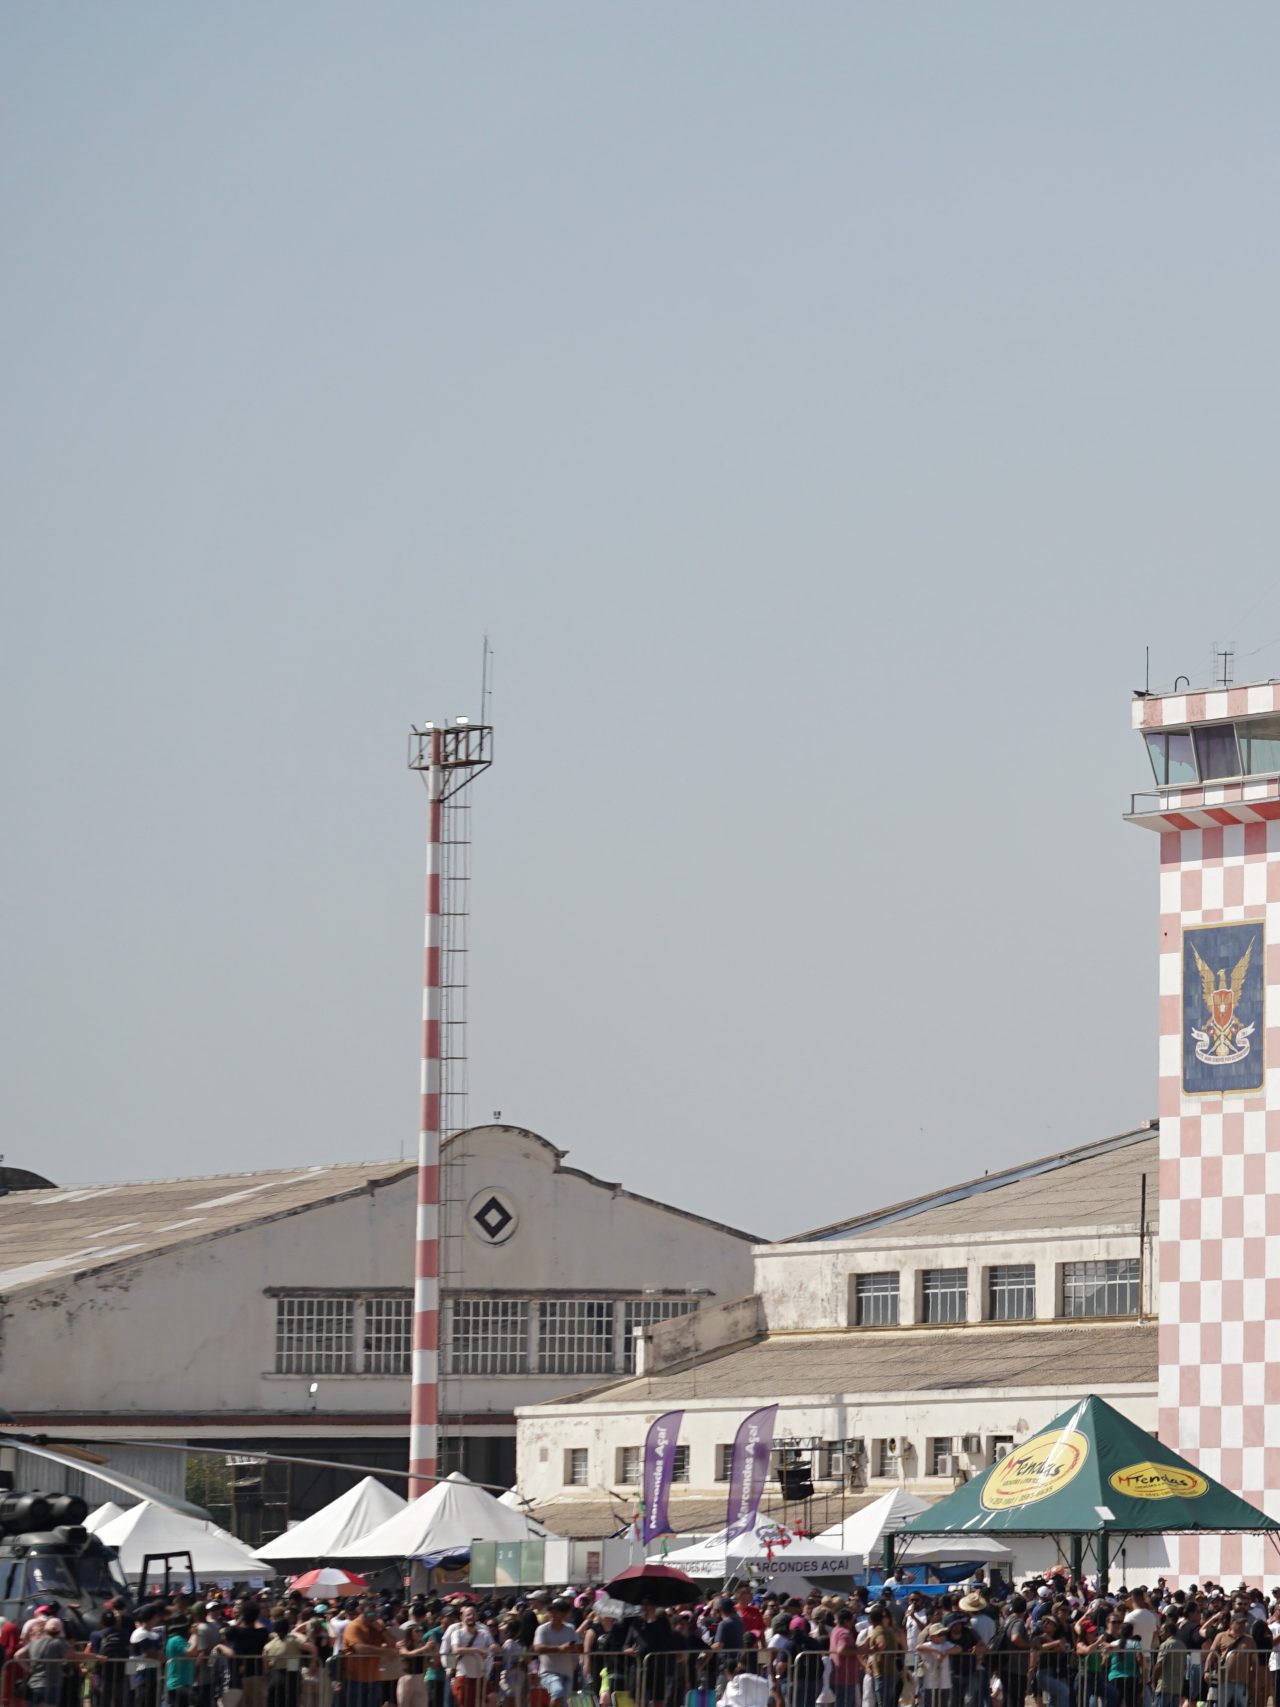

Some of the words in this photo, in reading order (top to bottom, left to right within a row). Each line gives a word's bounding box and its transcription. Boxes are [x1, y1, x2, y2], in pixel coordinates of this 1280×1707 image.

[649, 1459, 664, 1529] Marcondes
[737, 1457, 754, 1527] Marcondes
[820, 1557, 849, 1573] AÇAÍ
